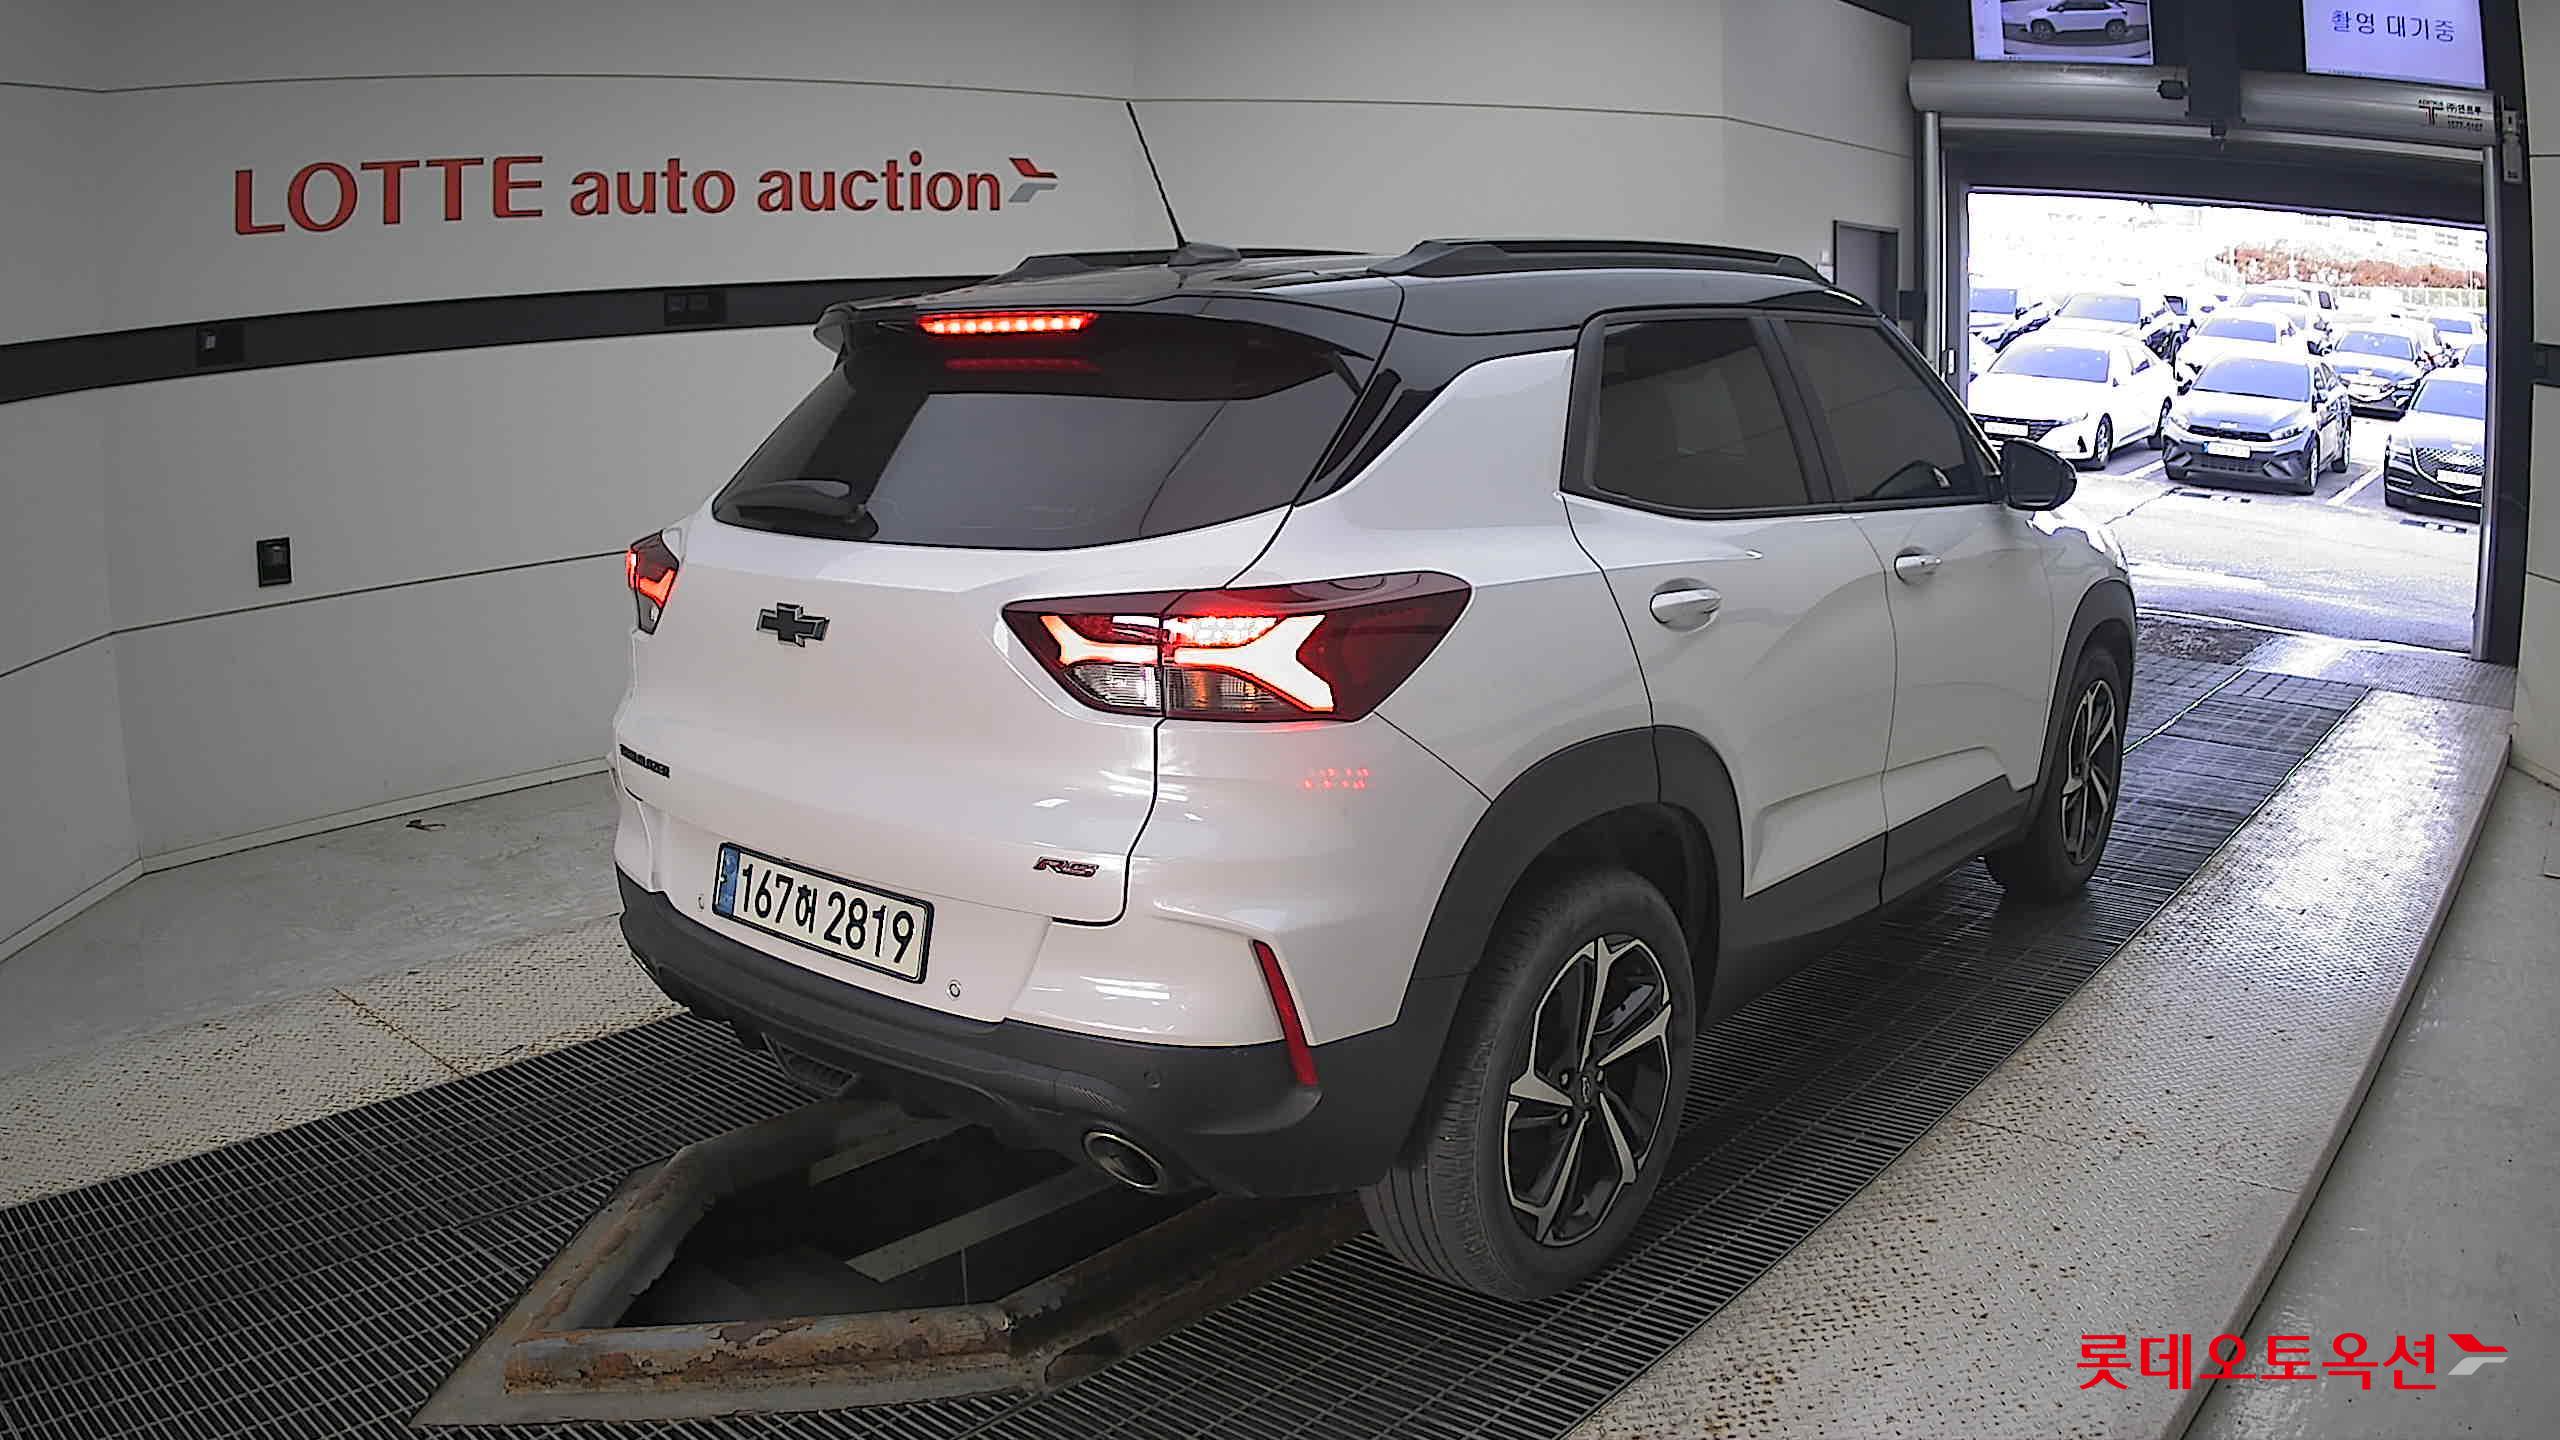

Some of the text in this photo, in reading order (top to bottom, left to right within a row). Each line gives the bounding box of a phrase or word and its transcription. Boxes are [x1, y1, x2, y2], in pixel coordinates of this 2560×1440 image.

[2331, 9, 2455, 42] 촬영 대기중
[235, 150, 1002, 236] LOTTE auto auction
[1033, 856, 1100, 878] RS
[822, 891, 915, 964] 2819
